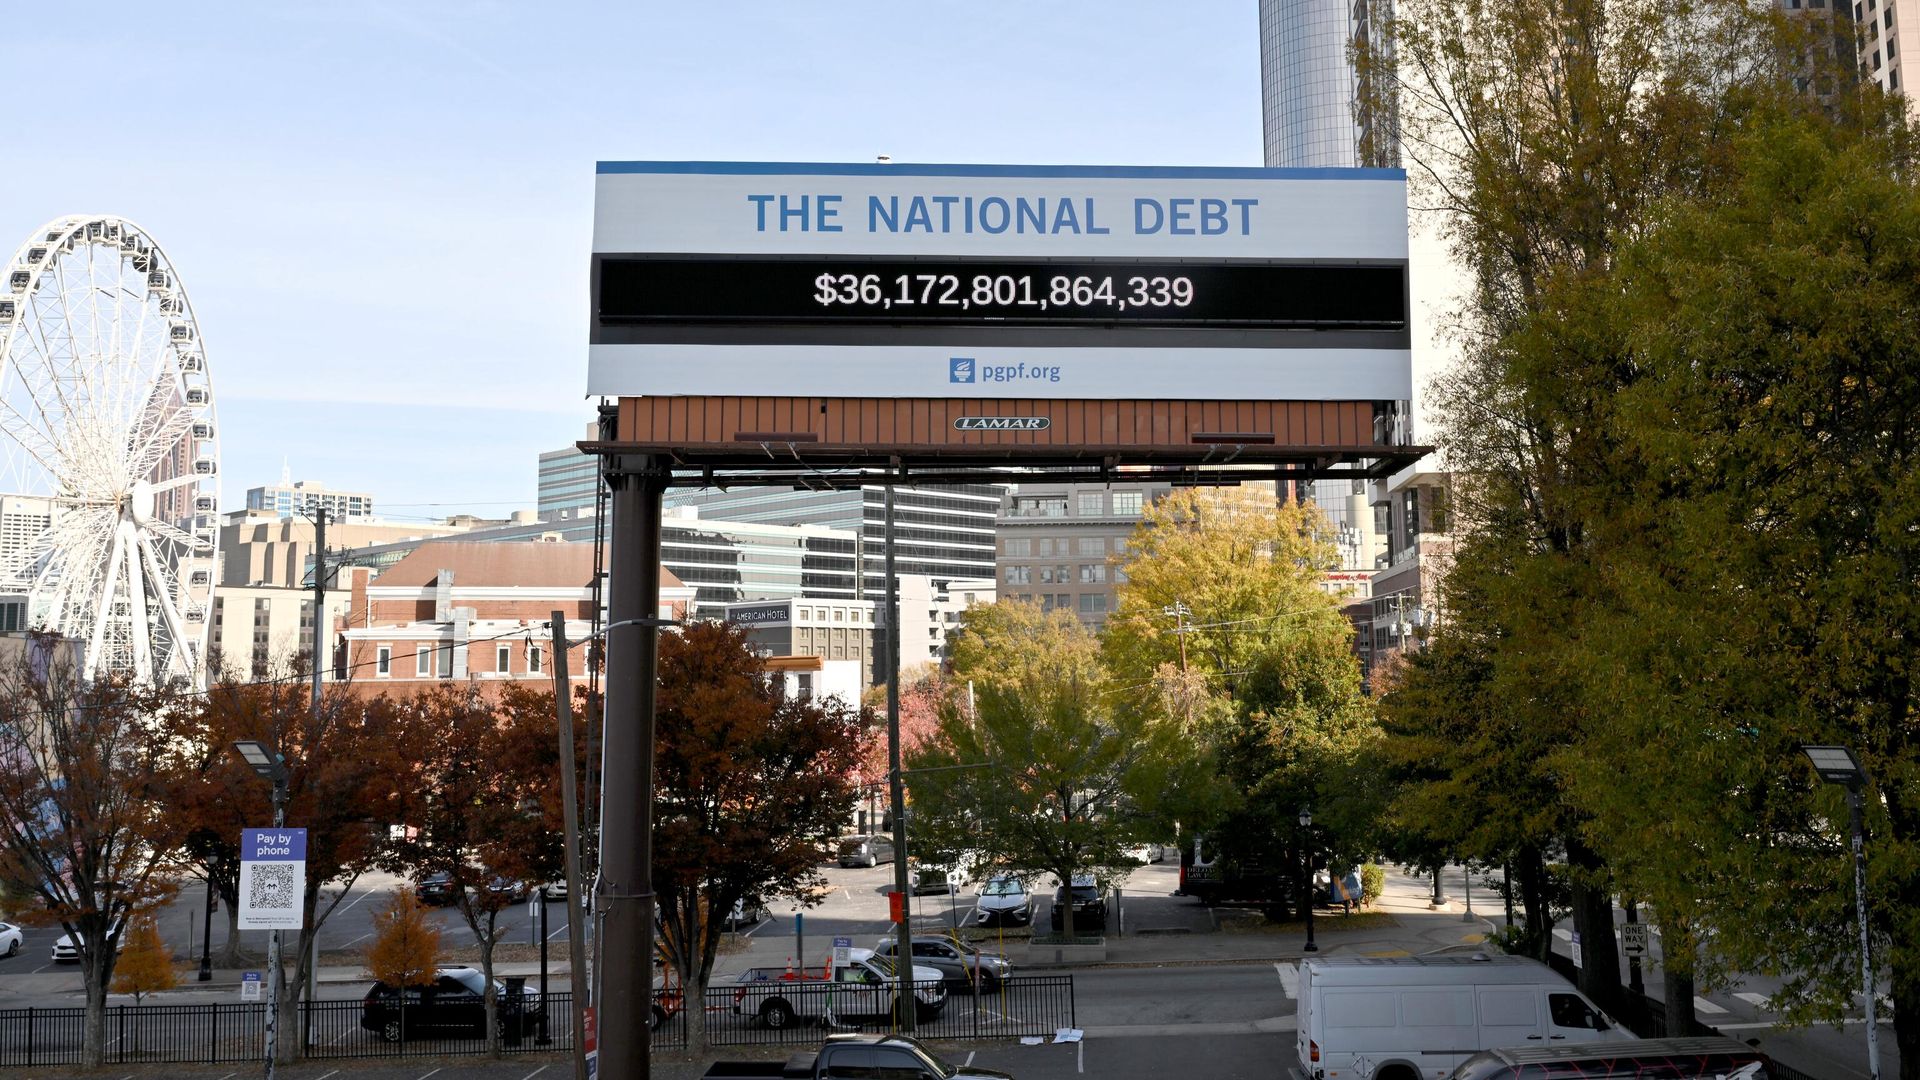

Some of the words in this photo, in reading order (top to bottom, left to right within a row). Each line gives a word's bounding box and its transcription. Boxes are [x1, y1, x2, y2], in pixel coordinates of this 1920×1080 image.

[748, 195, 843, 232] THE
[868, 195, 1110, 235] NATIONAL
[1134, 198, 1258, 236] DEBT
[814, 272, 1194, 311] $36,172,801,864,339
[983, 362, 1061, 382] pgpf.org
[962, 418, 1040, 429] LAMAR
[736, 611, 766, 621] AMERICAN
[766, 610, 787, 619] HOTEL
[257, 833, 276, 846] Pay
[278, 833, 292, 846] by
[257, 846, 290, 857] phone
[1625, 926, 1643, 935] ONE
[1625, 935, 1644, 943] WAY
